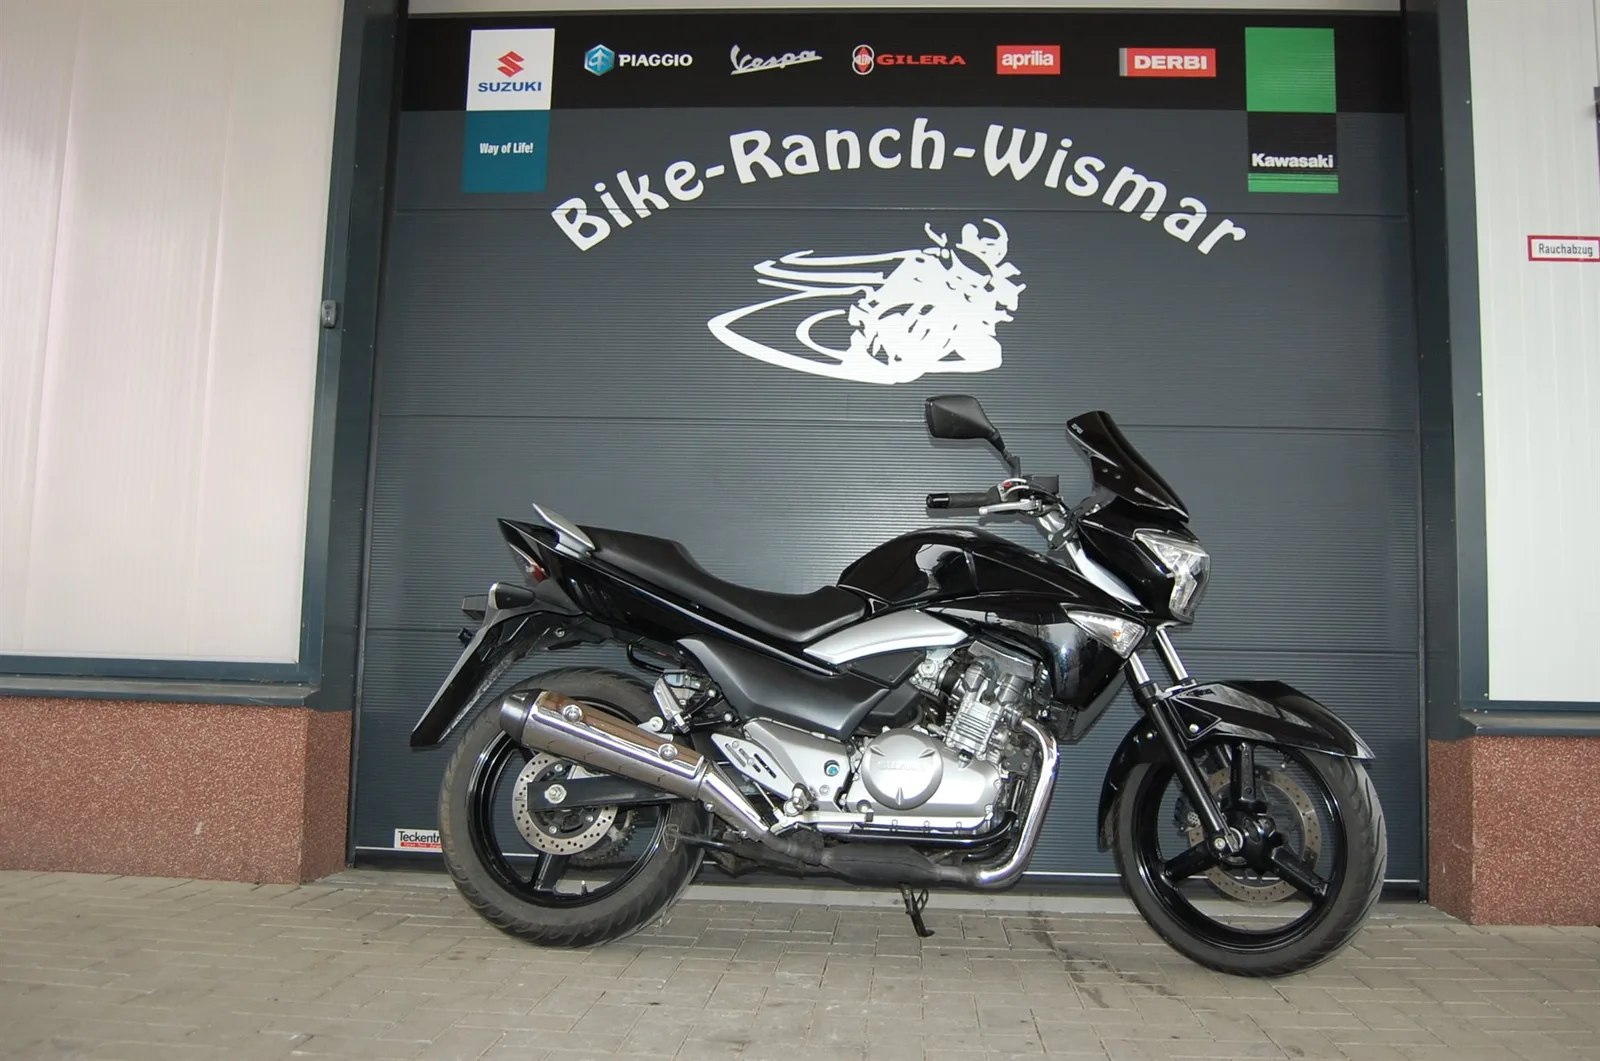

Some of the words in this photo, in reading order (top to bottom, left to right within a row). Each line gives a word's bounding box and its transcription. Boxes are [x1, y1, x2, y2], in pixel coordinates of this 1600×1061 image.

[619, 53, 693, 67] PIAGGIO
[730, 44, 823, 75] Vespa
[877, 53, 966, 67] GILERA
[1001, 50, 1054, 68] aprilia
[1134, 55, 1208, 70] DERBI
[478, 81, 542, 93] SUZUKI
[479, 143, 499, 155] Way
[501, 143, 511, 154] of
[513, 143, 534, 155] Life!
[1251, 152, 1334, 168] Kawasaki
[551, 117, 1248, 256] Bike-Ranch-Wismar
[1538, 243, 1593, 257] Rauchabzug
